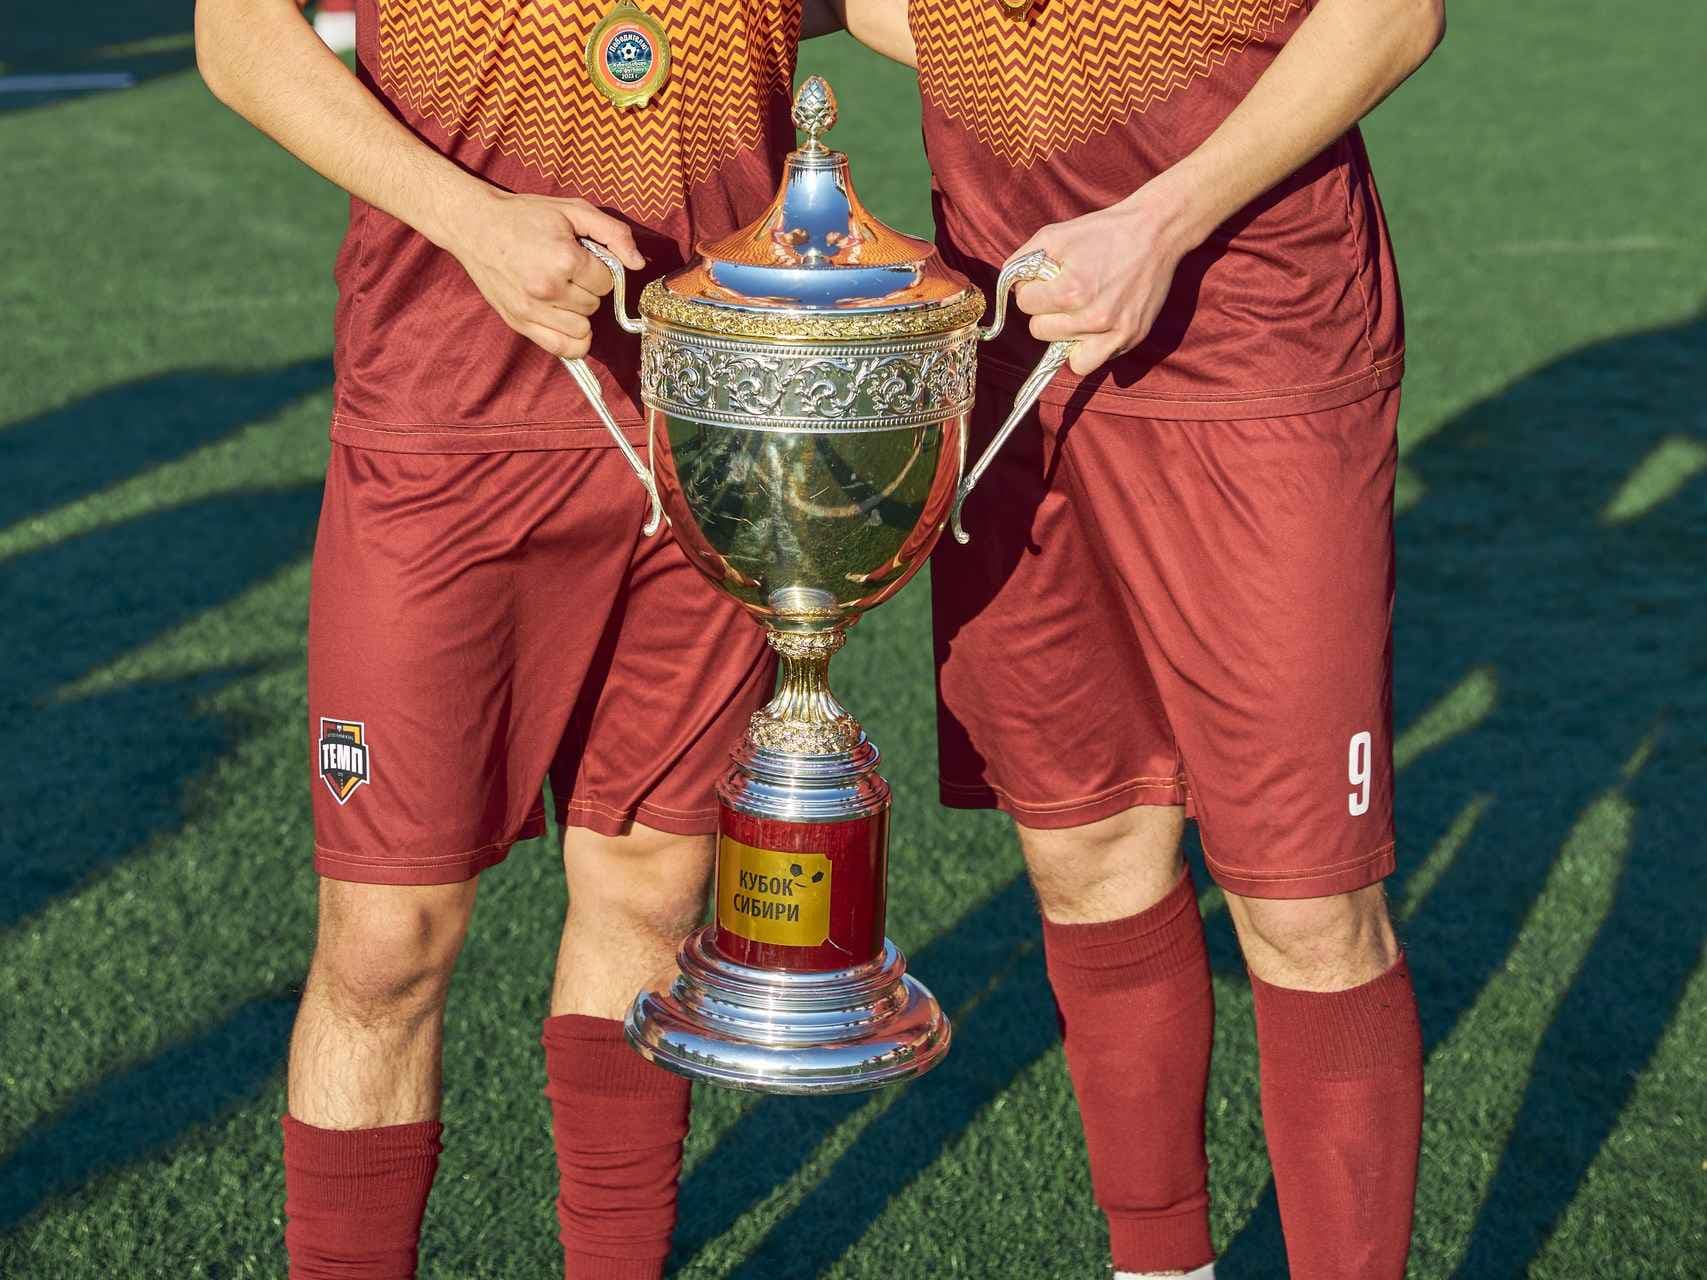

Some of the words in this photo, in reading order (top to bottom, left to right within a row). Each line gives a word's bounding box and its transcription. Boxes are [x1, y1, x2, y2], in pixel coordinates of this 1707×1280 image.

[322, 743, 364, 775] ТЕМП
[1348, 730, 1372, 816] 9
[739, 869, 794, 897] КУБОК
[733, 893, 800, 922] СИБИРИ
